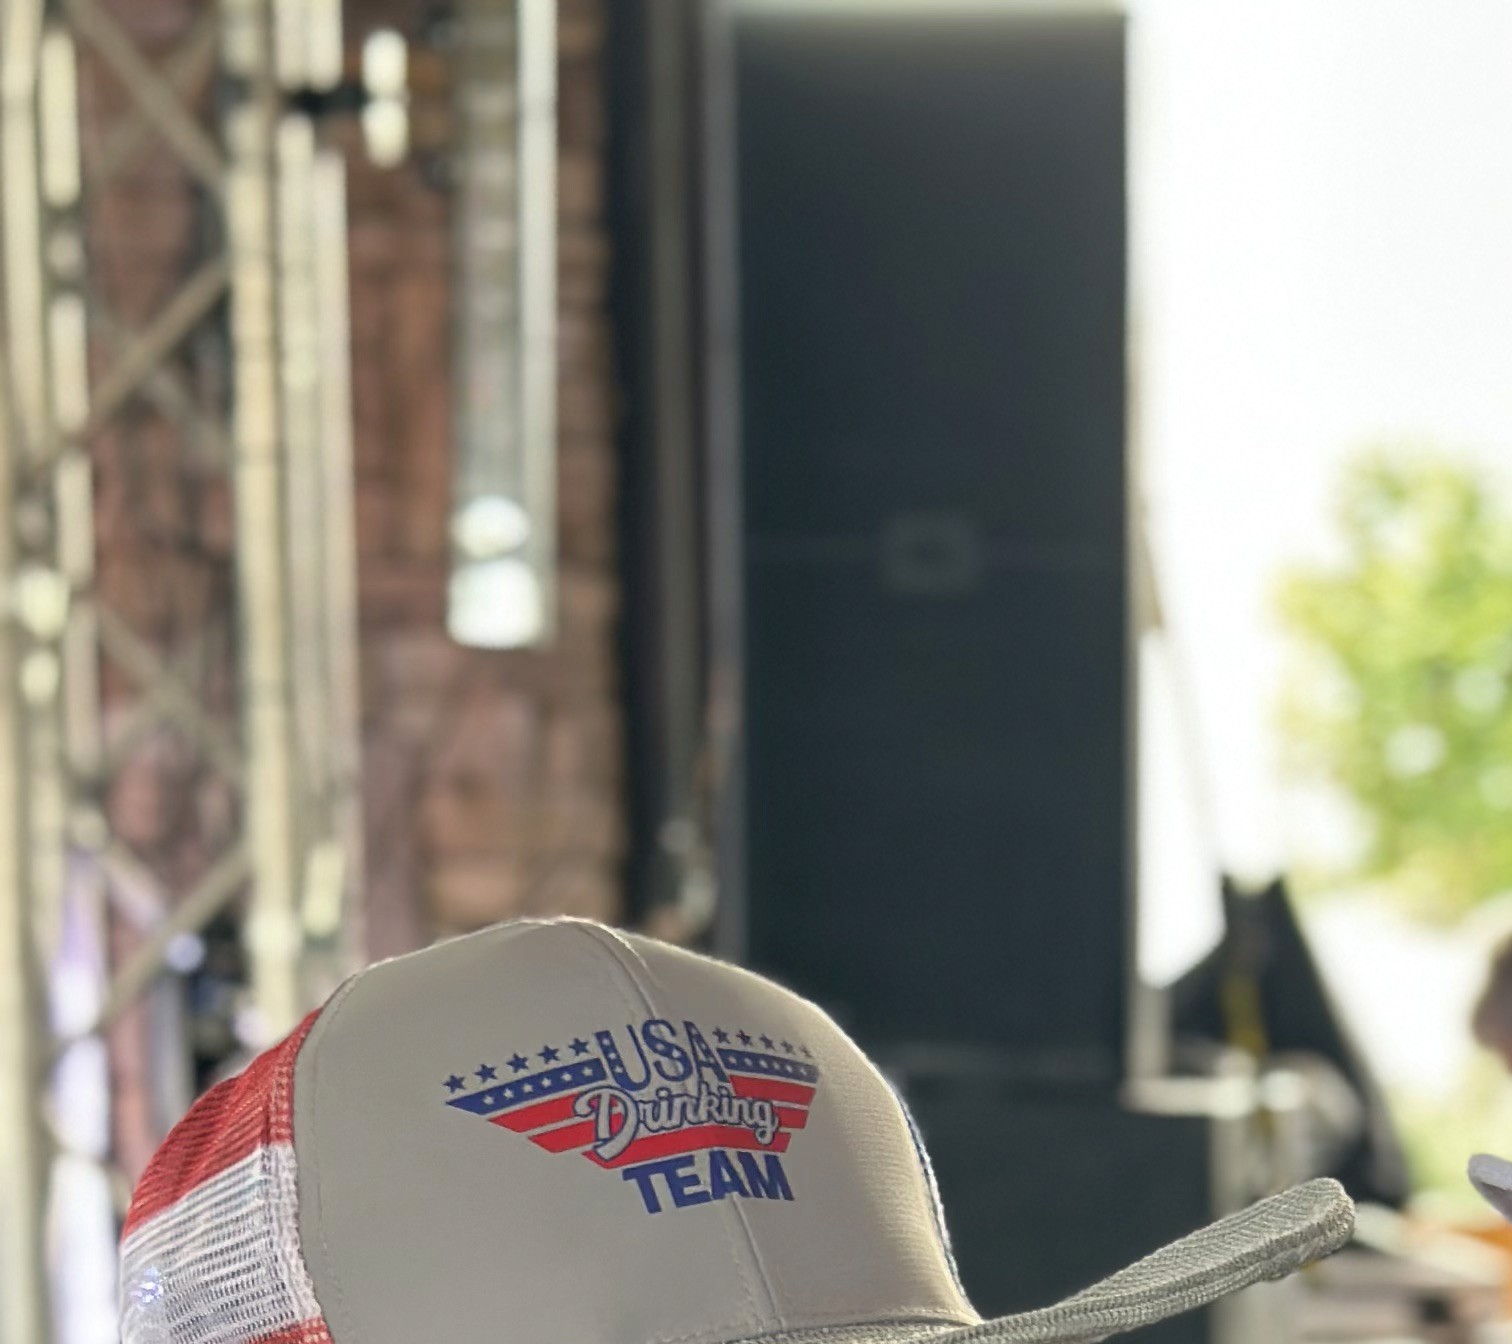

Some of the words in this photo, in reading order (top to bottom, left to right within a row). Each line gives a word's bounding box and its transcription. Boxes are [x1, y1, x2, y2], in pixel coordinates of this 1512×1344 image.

[595, 1019, 733, 1092] USA
[573, 1082, 779, 1160] Drinking
[622, 1151, 794, 1215] TEAM
